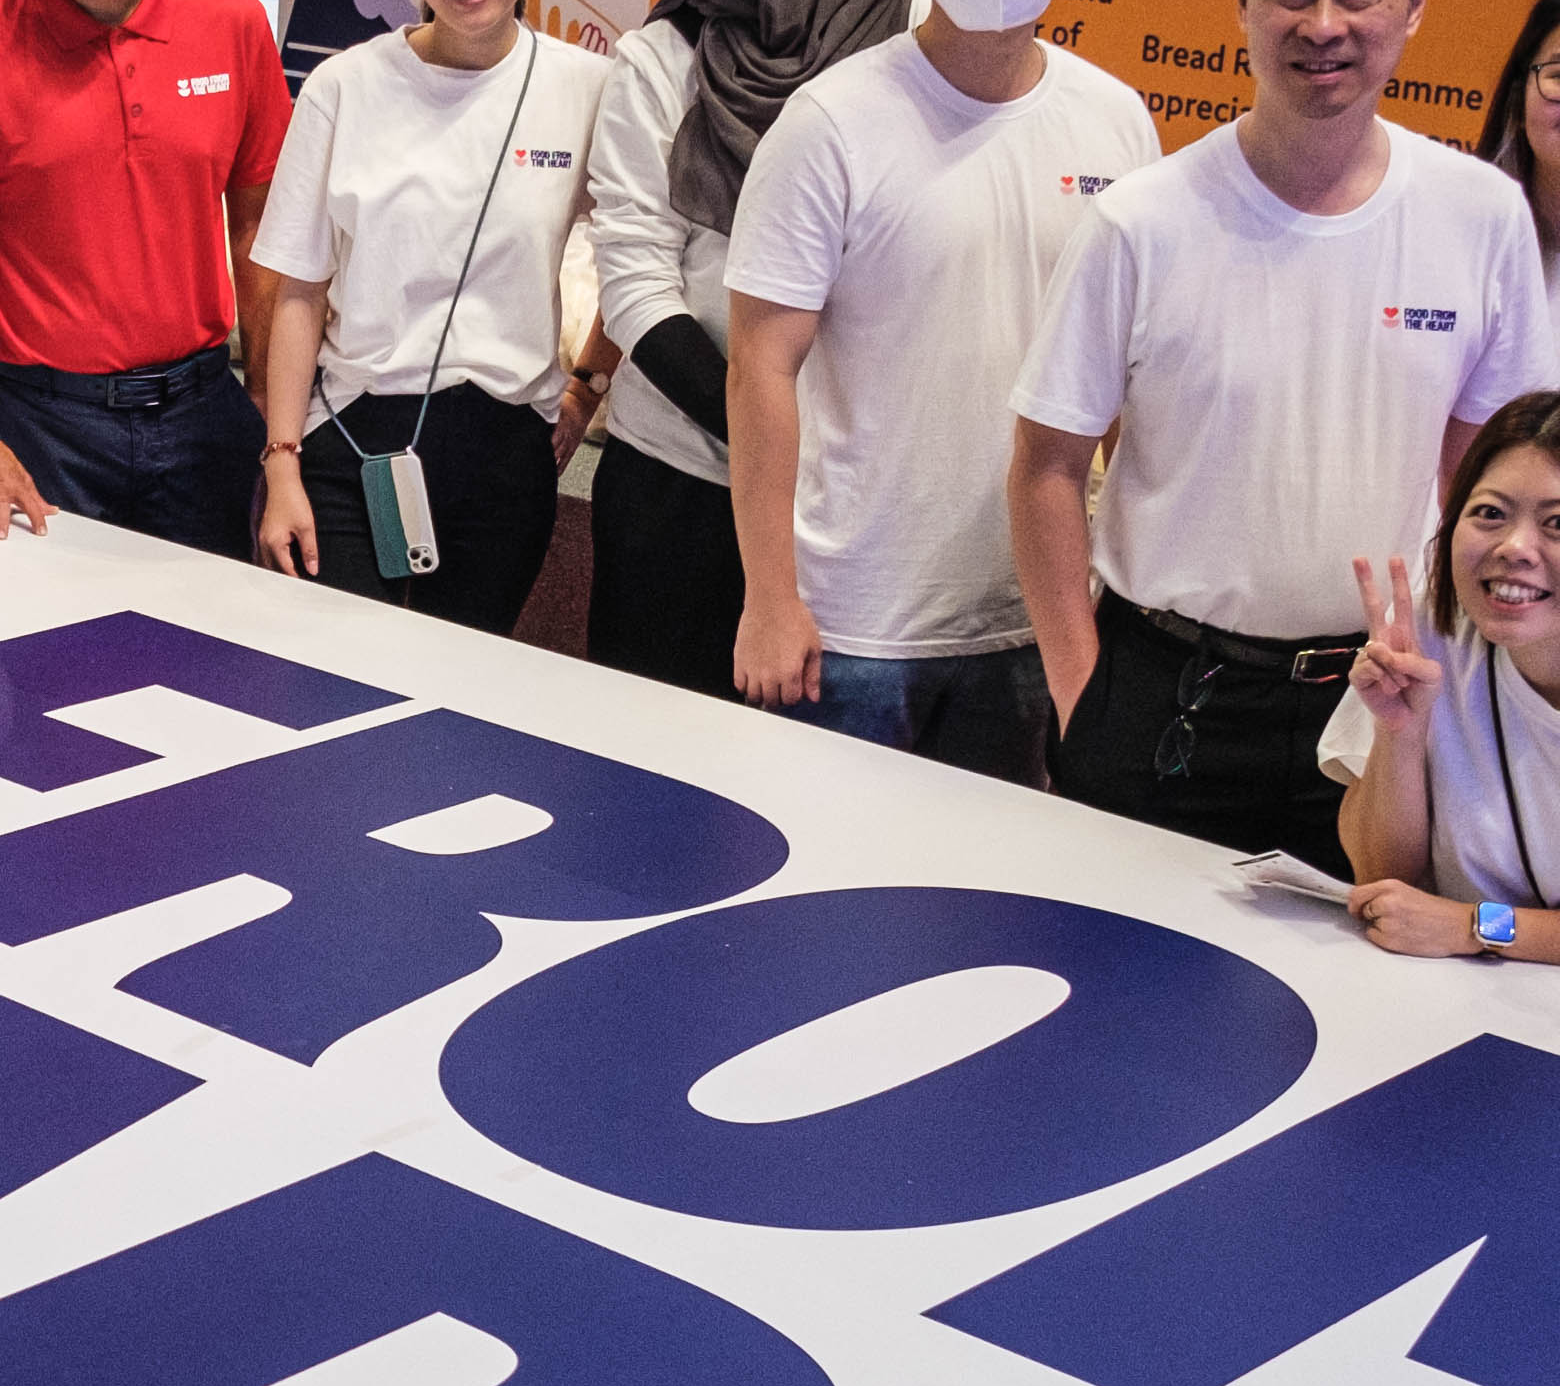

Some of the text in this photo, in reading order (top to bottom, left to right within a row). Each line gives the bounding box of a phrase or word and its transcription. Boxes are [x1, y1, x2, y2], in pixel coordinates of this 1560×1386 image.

[1053, 22, 1084, 47] of
[1142, 34, 1225, 73] Bread
[1383, 77, 1483, 111] amme
[1404, 308, 1457, 321] FOOD FROM
[1405, 319, 1456, 332] THE HEART
